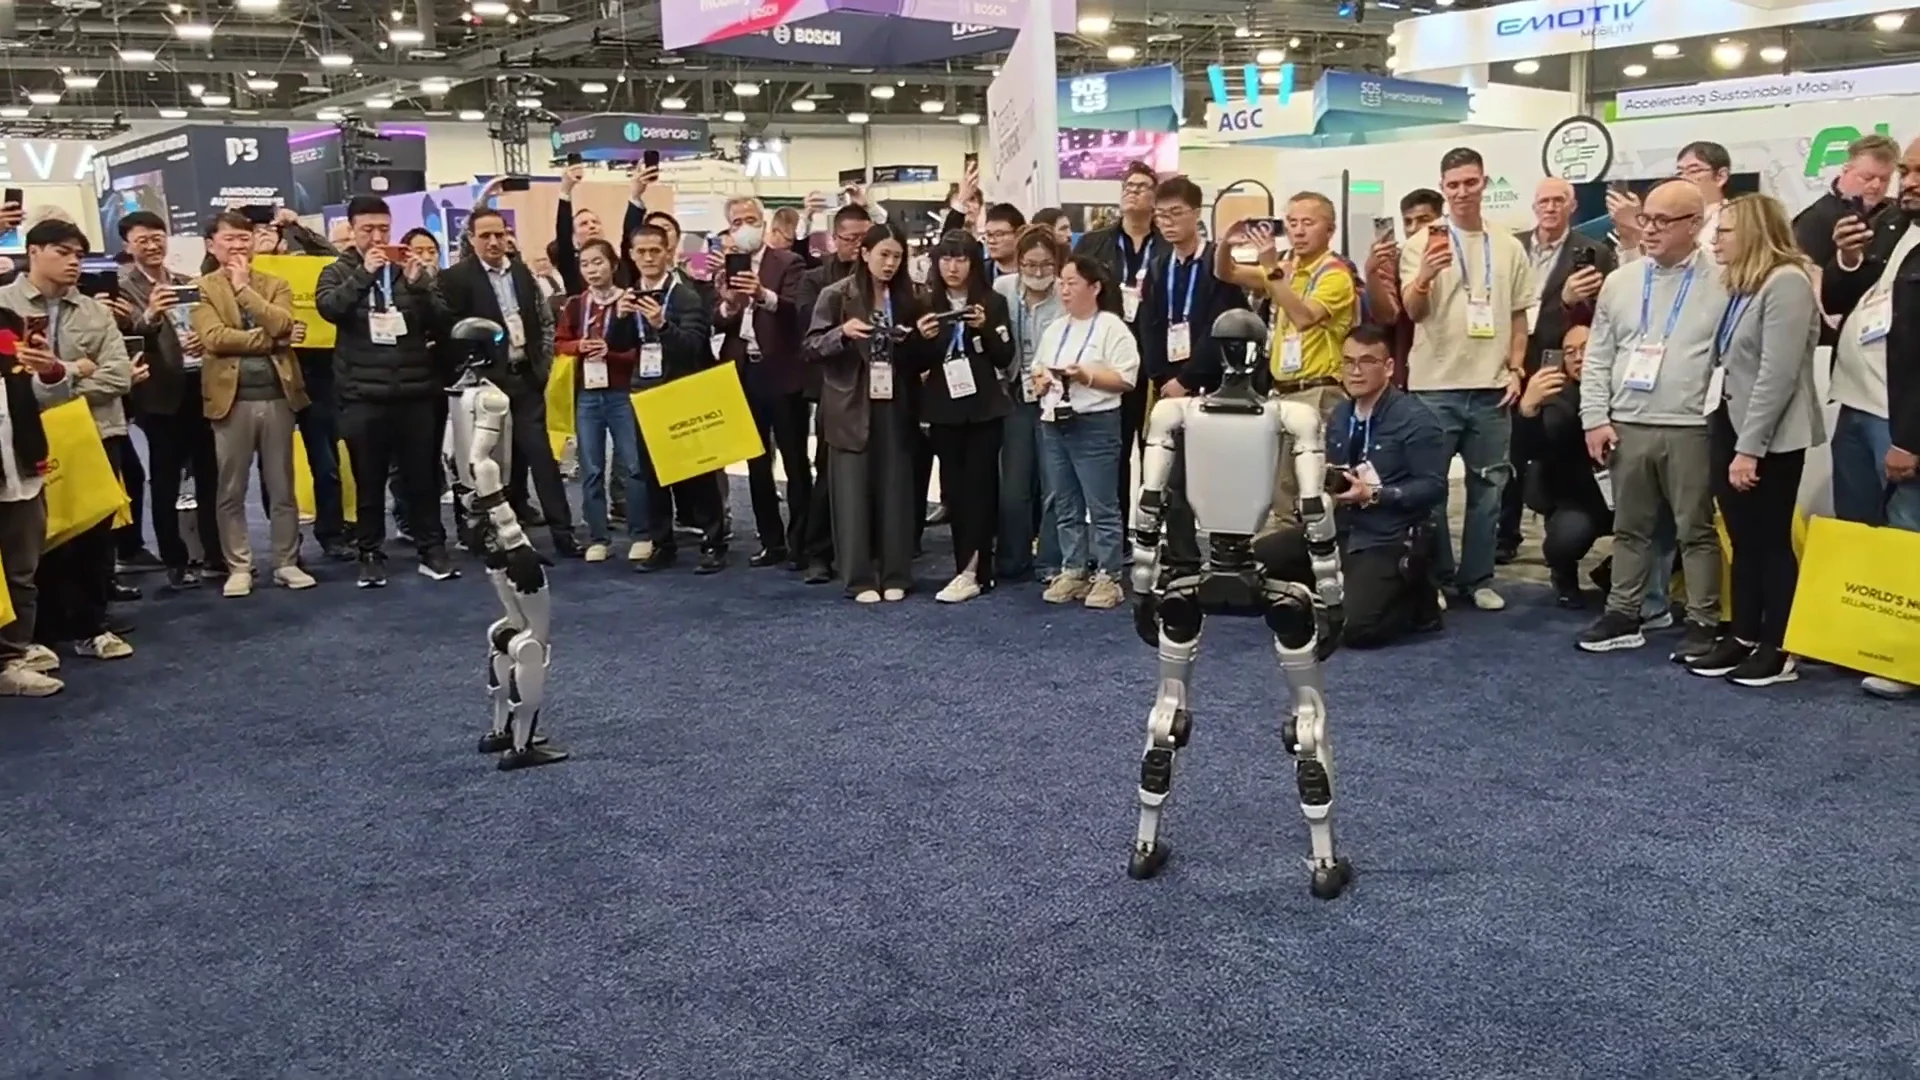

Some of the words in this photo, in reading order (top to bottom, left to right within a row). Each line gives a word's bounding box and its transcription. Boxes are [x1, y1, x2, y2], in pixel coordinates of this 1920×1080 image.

[1497, 0, 1645, 36] EMOTIV
[1580, 22, 1634, 38] MOBILITY
[794, 28, 841, 46] BOSCH
[1624, 93, 1706, 111] Accelerating
[1709, 85, 1792, 103] Sustainable
[1796, 79, 1856, 99] Mobility
[1218, 108, 1263, 132] AGC
[641, 126, 690, 140] cerence
[225, 137, 259, 166] P3
[1841, 596, 1876, 611] SELLING
[1845, 582, 1904, 606] WORLD'S
